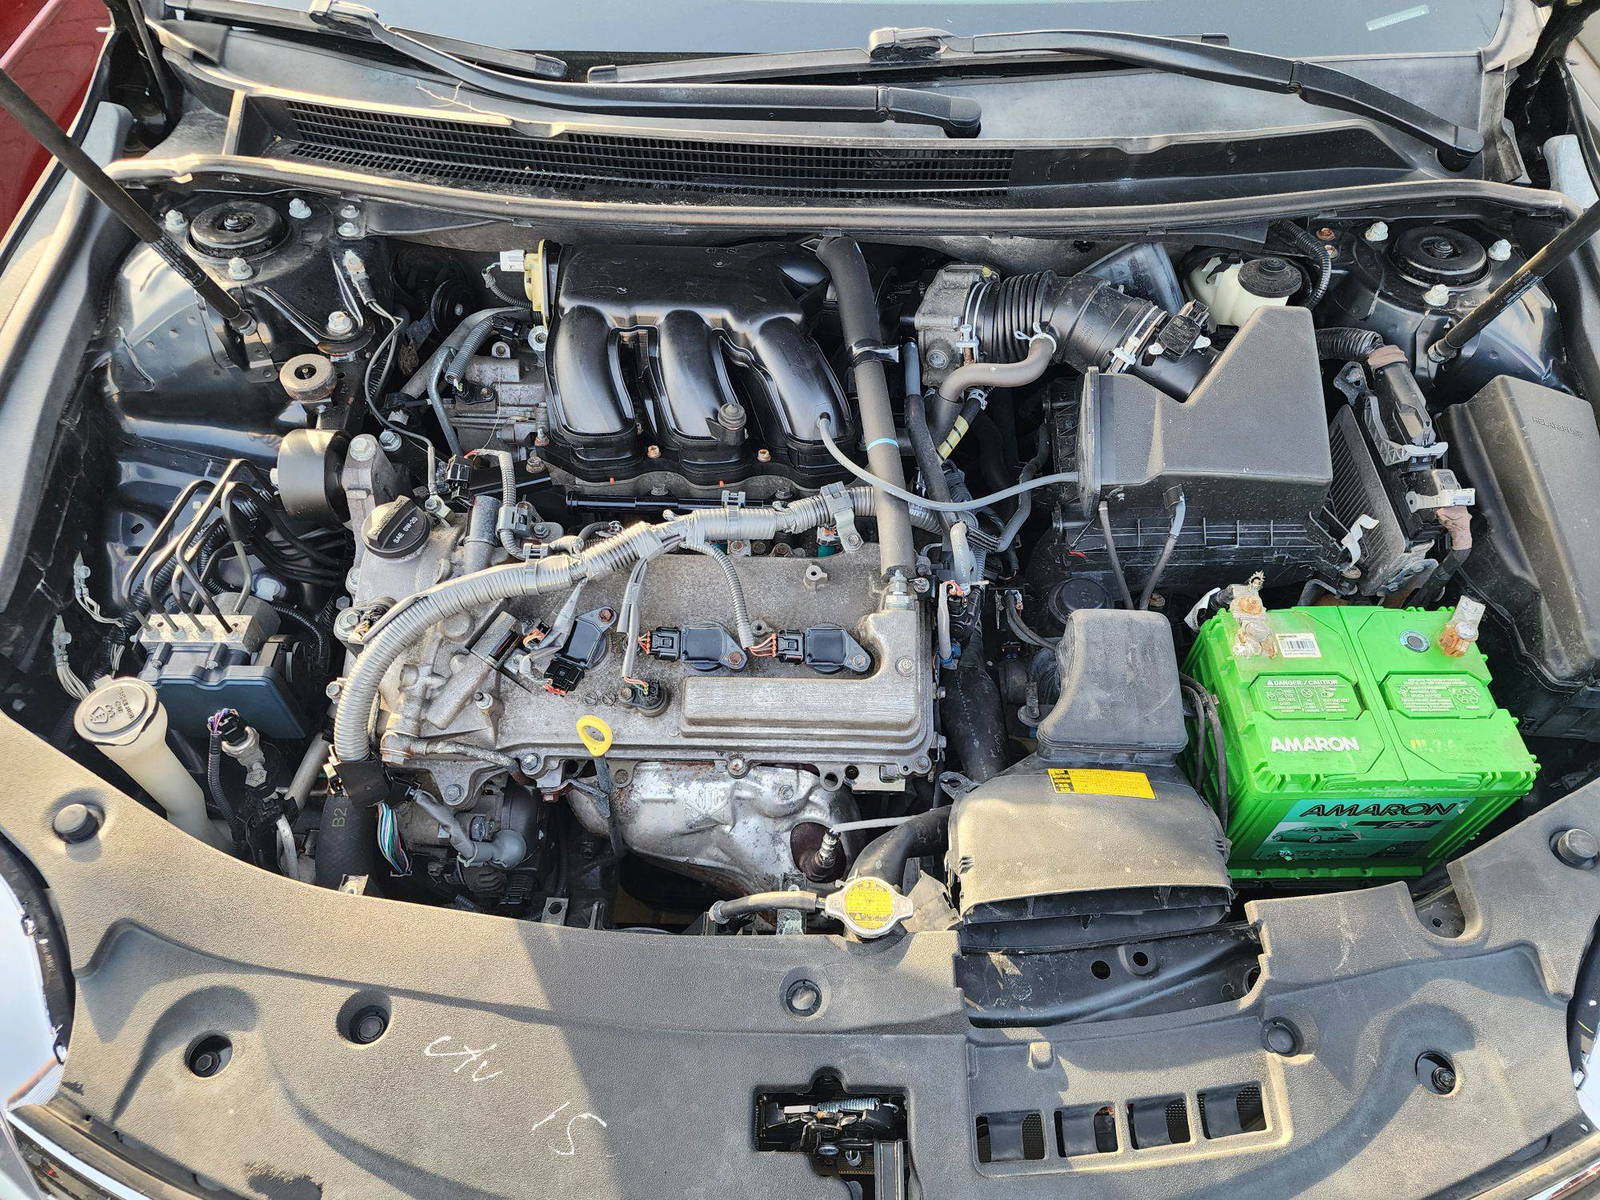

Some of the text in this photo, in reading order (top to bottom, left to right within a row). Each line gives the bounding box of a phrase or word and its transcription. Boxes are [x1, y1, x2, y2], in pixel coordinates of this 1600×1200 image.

[393, 532, 404, 544] SAE
[1271, 736, 1359, 752] AMARON
[1299, 802, 1458, 817] AMARON
[331, 807, 348, 828] B2
